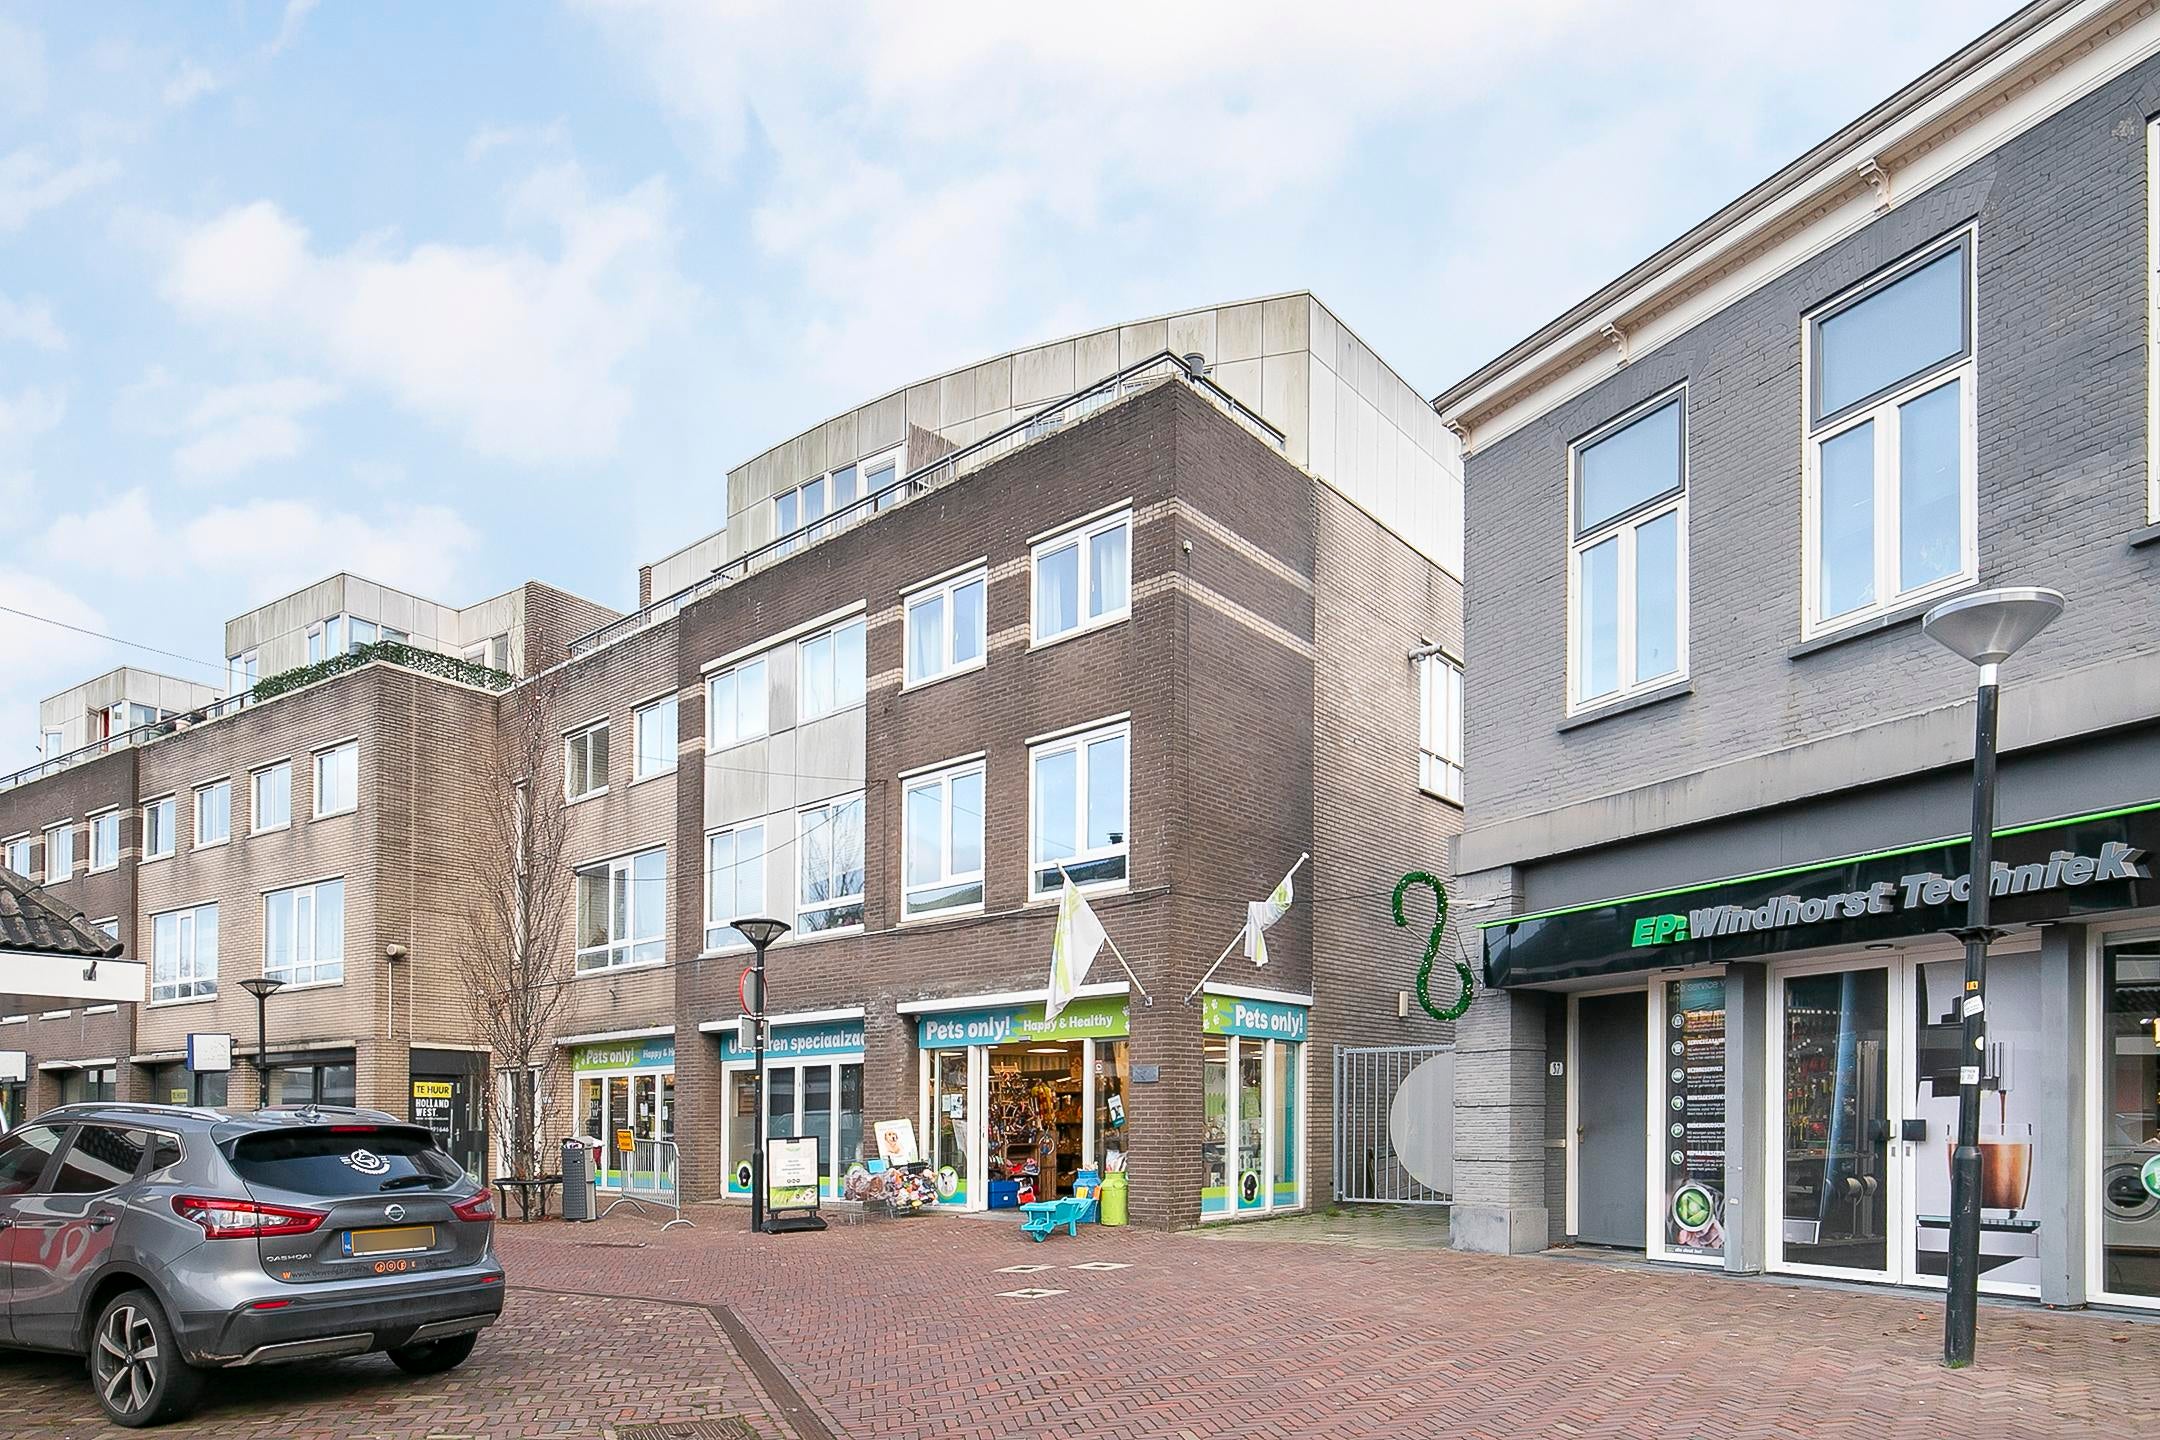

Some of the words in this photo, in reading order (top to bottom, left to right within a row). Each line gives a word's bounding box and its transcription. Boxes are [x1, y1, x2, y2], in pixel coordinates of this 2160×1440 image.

[1900, 841, 2144, 909] Techniek
[926, 1020, 964, 1041] Pets
[967, 1015, 1010, 1041] only!
[1023, 1018, 1056, 1033] Happy
[1059, 1017, 1066, 1029] &
[1069, 1014, 1113, 1029] Healthy
[1235, 1004, 1268, 1030] Pets
[1271, 1011, 1304, 1038] only!
[586, 1049, 608, 1065] Pets
[609, 1046, 634, 1066] only!
[642, 1049, 661, 1060] Happy
[416, 1085, 425, 1094] TE
[427, 1085, 449, 1095] HUUR
[415, 1098, 449, 1108] HOLLAND
[416, 1107, 438, 1117] WEST.
